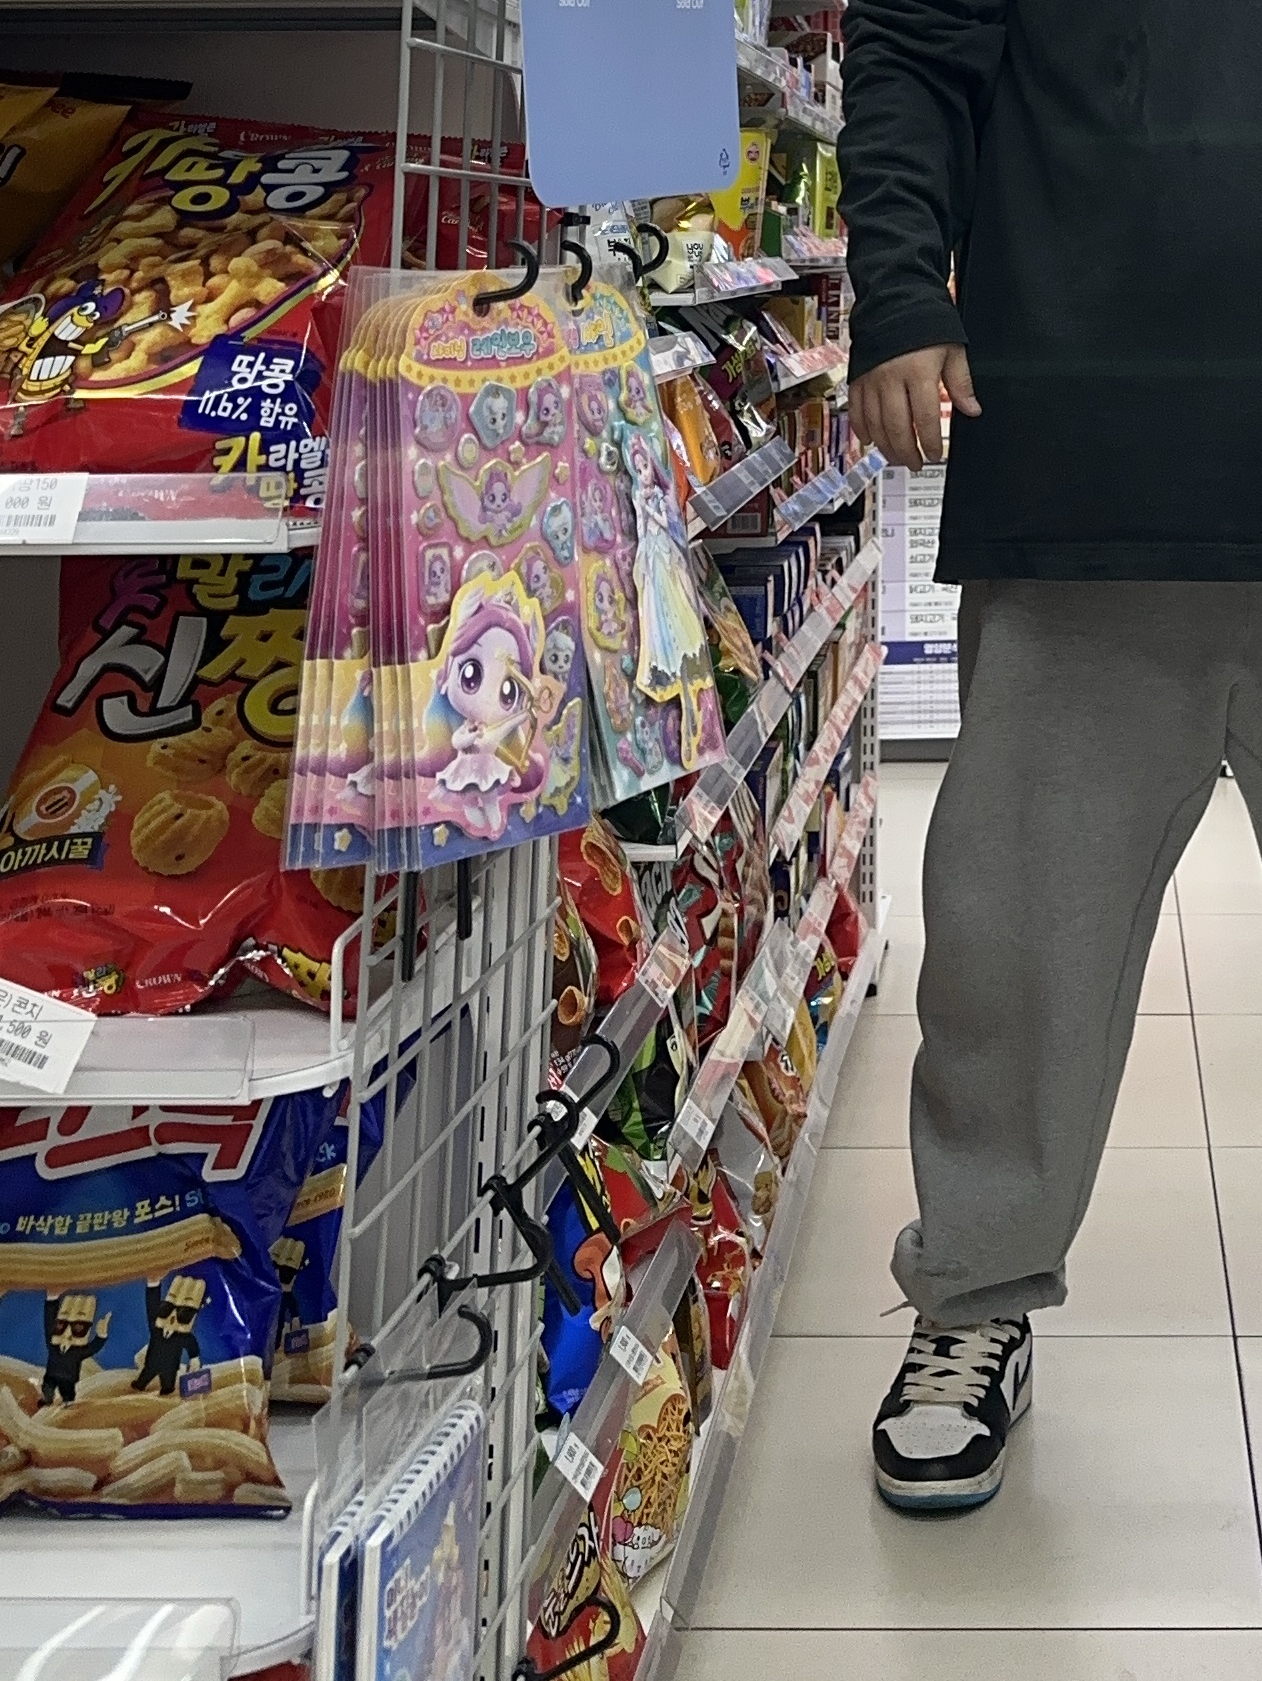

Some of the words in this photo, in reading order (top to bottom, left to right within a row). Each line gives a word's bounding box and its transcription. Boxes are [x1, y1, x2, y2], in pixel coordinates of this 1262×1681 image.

[230, 353, 296, 392] 땅콩
[259, 398, 299, 431] 함유
[37, 495, 53, 511] 원
[136, 973, 183, 989] CROWN
[34, 1029, 53, 1049] 원
[133, 1195, 181, 1223] 포스!
